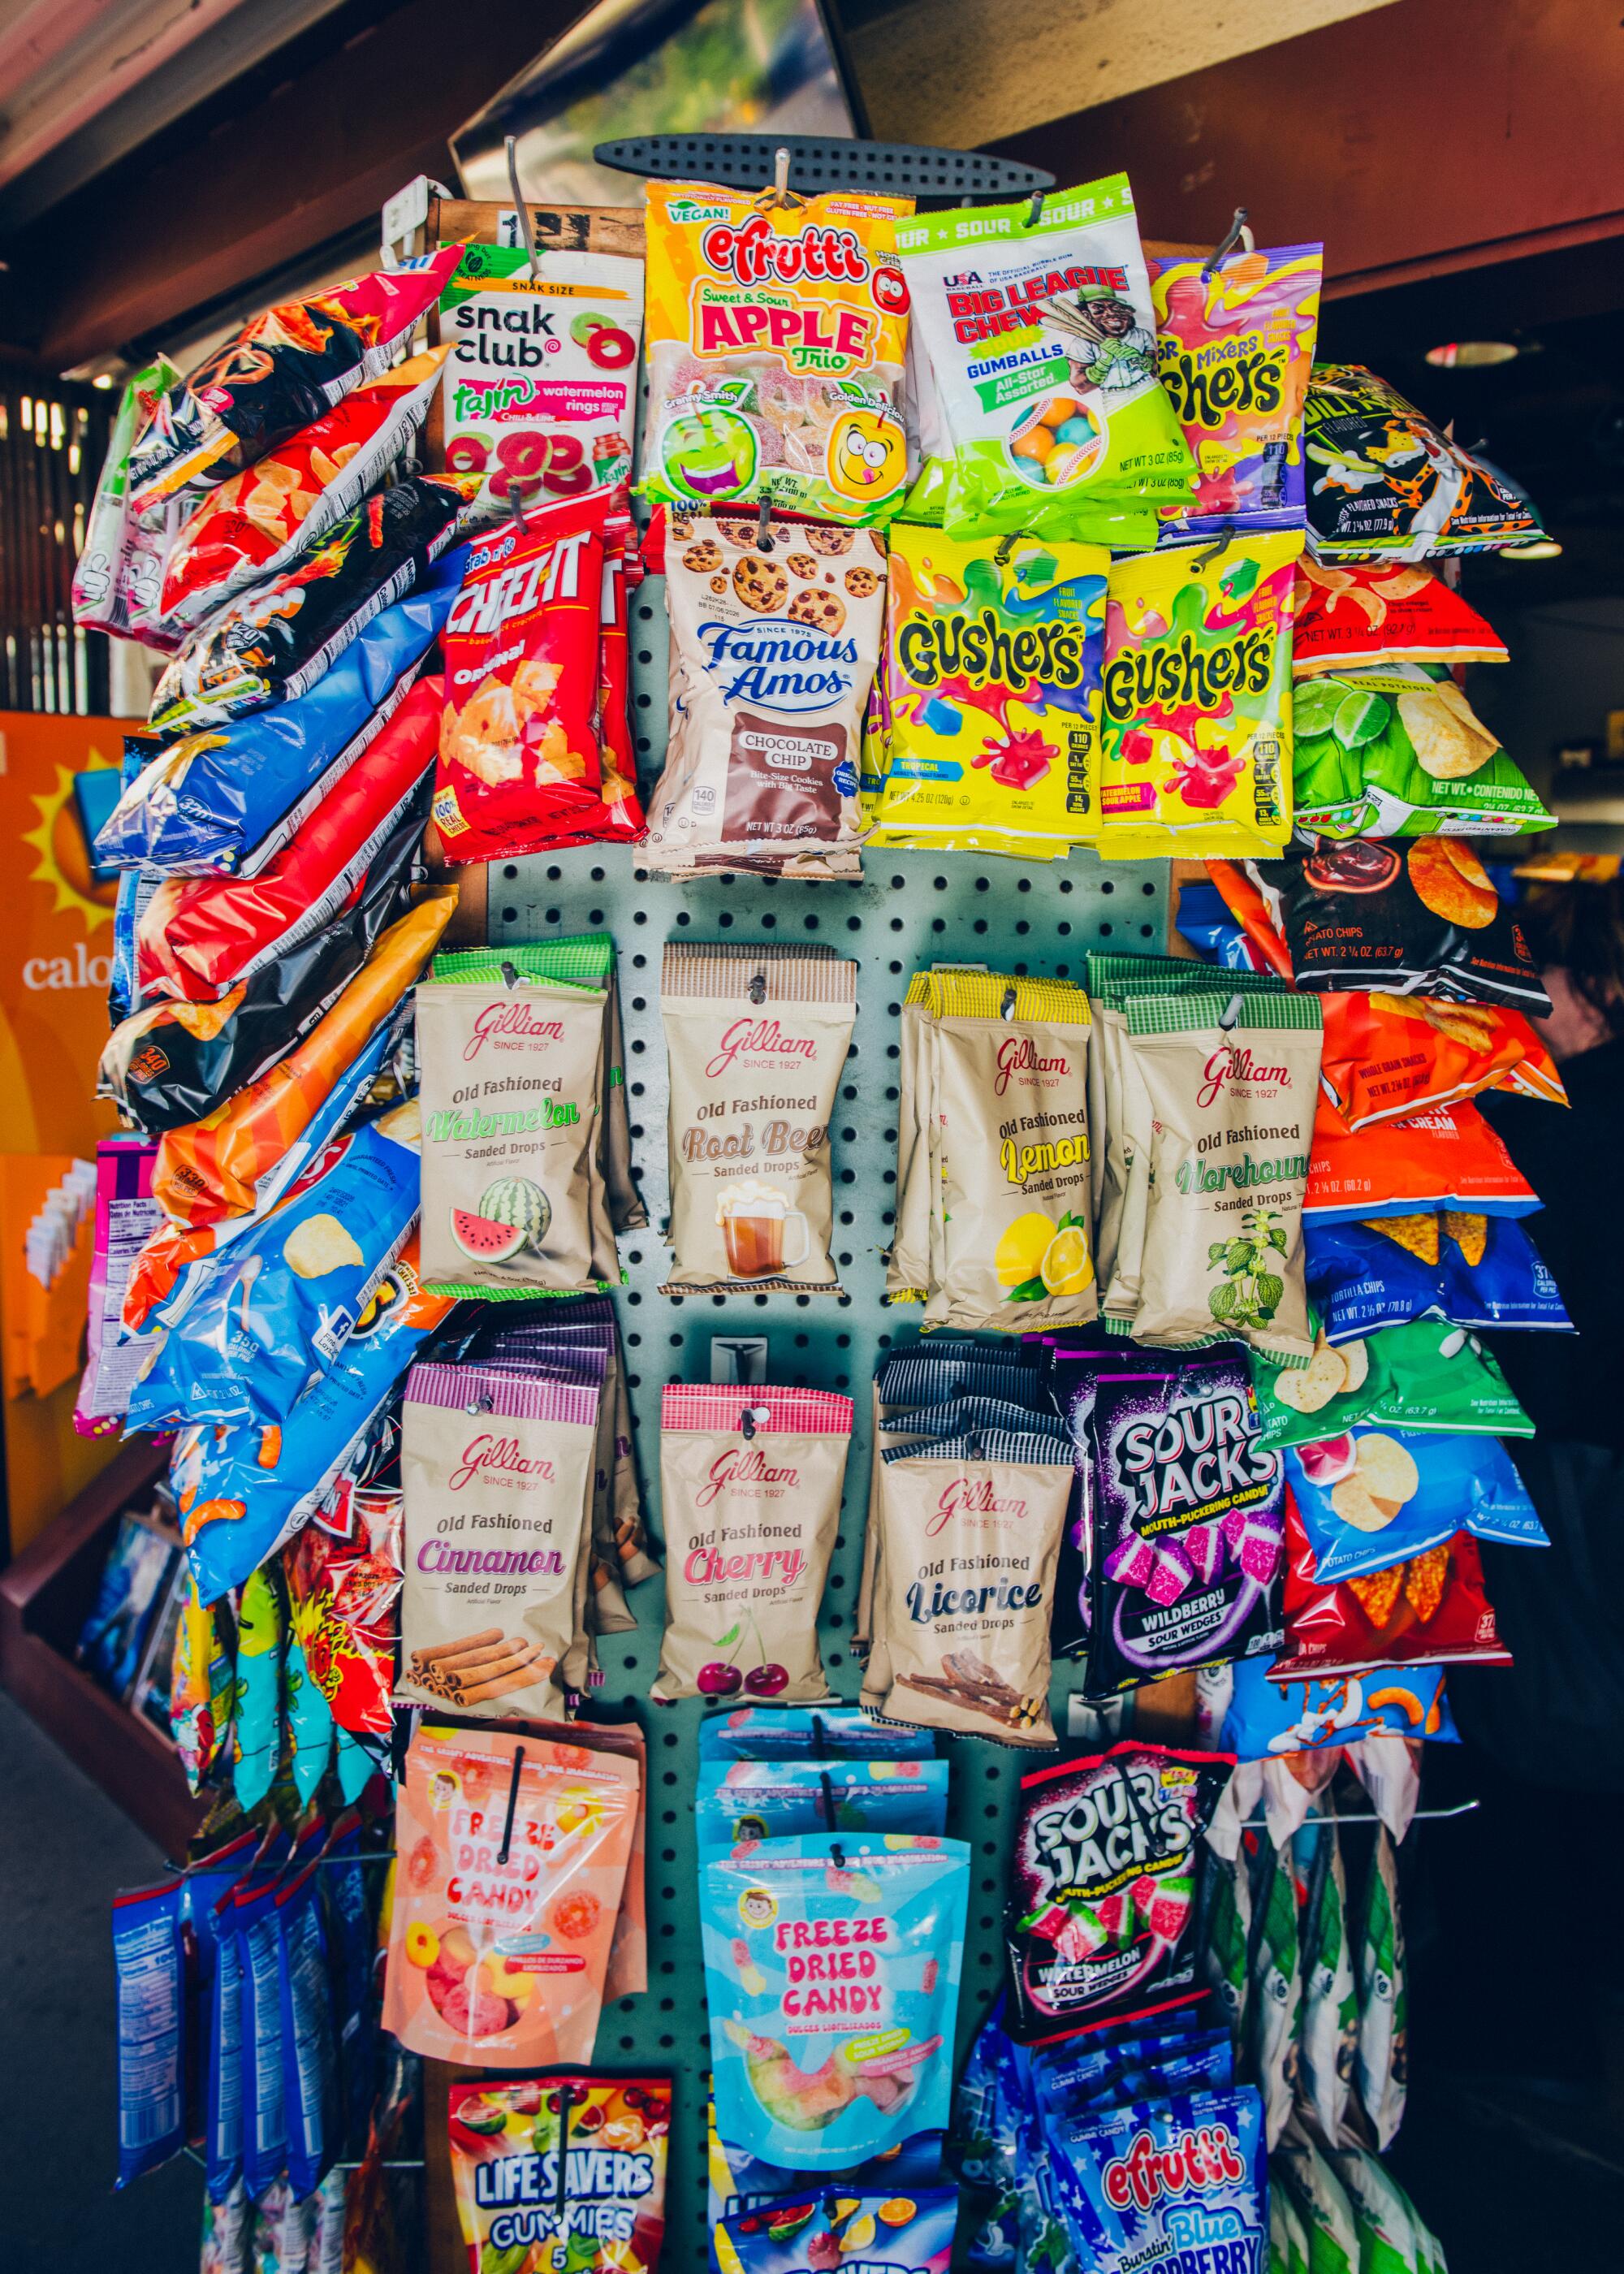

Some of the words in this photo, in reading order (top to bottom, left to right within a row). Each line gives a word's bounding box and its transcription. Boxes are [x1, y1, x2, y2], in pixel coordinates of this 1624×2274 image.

[670, 207, 729, 223] VEGAN!
[956, 218, 1010, 240] SOUR
[706, 217, 869, 286] efrutti
[512, 281, 544, 294] SNAK
[550, 283, 575, 296] SIZE
[943, 270, 983, 287] USA
[703, 289, 741, 304] Sweet
[745, 294, 754, 304] &
[757, 293, 788, 306] Sour
[946, 286, 1005, 318] BIG
[1006, 265, 1129, 309] LEAGUE
[456, 304, 555, 335] snak
[702, 305, 869, 356] APPLE
[454, 333, 543, 368] club
[792, 347, 846, 372] Trio
[967, 344, 1064, 379] GUMBALLS
[996, 365, 1046, 392] All-Star
[996, 374, 1057, 404] Assorted
[542, 386, 623, 400] watermelon
[663, 393, 703, 410] Granny
[702, 390, 739, 403] Smith
[828, 391, 866, 406] Golden
[566, 400, 600, 415] rings
[1120, 460, 1134, 472] NET
[1134, 457, 1147, 469] WT
[1154, 454, 1165, 464] OZ
[1377, 496, 1399, 508] SNACKS
[1059, 586, 1076, 597] FRUIT
[1053, 598, 1082, 610] FLAVORED
[1058, 609, 1079, 620] SNACKS
[756, 626, 788, 634] SINCE
[791, 628, 812, 638] 1975
[1307, 629, 1324, 643] NET
[1327, 627, 1344, 642] WT.
[697, 622, 859, 672] Famous
[899, 611, 1083, 690] Gushers
[1105, 627, 1274, 720] Gushers
[719, 666, 853, 705] Amos
[1353, 680, 1379, 690] REAL
[1382, 682, 1432, 693] POTATOES
[1061, 721, 1072, 729] PER
[745, 734, 832, 757] CHOCOLATE
[1072, 733, 1088, 744] 110
[771, 753, 806, 767] CHIP
[900, 761, 939, 772] TROPICAL
[750, 771, 789, 782] Bite-Size
[791, 776, 823, 787] Cookies
[756, 780, 775, 789] with
[793, 785, 818, 794] Taste
[838, 777, 857, 789] RECIPE
[1432, 781, 1449, 795] NET
[1450, 783, 1466, 796] WT.
[1474, 785, 1522, 799] CONTENIDO
[694, 789, 714, 802] 140
[926, 793, 935, 804] OZ
[440, 815, 461, 829] REAL
[447, 821, 469, 838] CHEESE
[747, 822, 762, 832] NET
[1336, 926, 1363, 939] CHIPS
[1321, 946, 1338, 959] WT.
[1340, 946, 1346, 958] 2
[464, 1002, 564, 1061] Gilliam
[494, 1041, 525, 1052] SINCE
[528, 1042, 549, 1053] 1927
[705, 1018, 818, 1079] Gilliam
[140, 1048, 167, 1071] 340
[742, 1058, 775, 1070] SINCE
[779, 1061, 801, 1070] 1927
[995, 1038, 1070, 1096] Gilliam
[1358, 1061, 1384, 1079] WHOLE
[1018, 1076, 1040, 1087] SINCE
[1041, 1078, 1060, 1088] 1927
[1196, 1047, 1291, 1109] Gilliam
[452, 1083, 479, 1105] Old
[484, 1077, 563, 1096] Fashioned
[1229, 1087, 1252, 1098] SINCE
[1255, 1089, 1277, 1099] 1927
[697, 1100, 726, 1122] Old
[732, 1095, 817, 1115] Fashioned
[425, 1098, 580, 1143] Watermelon
[998, 1120, 1019, 1140] Old
[1021, 1109, 1086, 1134] Fashioned
[1409, 1118, 1457, 1133] CREAM
[682, 1122, 754, 1164] Root
[1197, 1132, 1222, 1154] Old
[1227, 1124, 1300, 1147] Fashioned
[464, 1143, 506, 1161] Sanded
[510, 1141, 546, 1156] Drops
[1000, 1132, 1091, 1187] Lemon
[713, 1163, 760, 1178] Sanded
[763, 1159, 800, 1175] Drops
[1307, 1161, 1331, 1175] CHIPS
[1021, 1180, 1054, 1197] Sanded
[1056, 1173, 1085, 1191] Drops
[1213, 1196, 1254, 1213] Sanded
[1256, 1191, 1293, 1208] Drops
[1331, 1286, 1363, 1304] TORTILLA
[1364, 1281, 1385, 1295] CHIPS
[1332, 1308, 1347, 1324] NET
[1348, 1307, 1360, 1321] WT.
[230, 1330, 260, 1354] 350
[1126, 1398, 1243, 1473] SOUR
[448, 1433, 555, 1491] Gilliam
[483, 1476, 513, 1489] SINCE
[516, 1481, 539, 1491] 1927
[695, 1449, 801, 1508] Gilliam
[731, 1488, 762, 1498] SINCE
[764, 1489, 785, 1498] 1927
[925, 1478, 1028, 1537] Gilliam
[1140, 1498, 1232, 1537] MOUTH-PUCKERING
[437, 1515, 464, 1534] Old
[470, 1513, 552, 1535] Fashioned
[961, 1518, 990, 1528] SINCE
[991, 1519, 1014, 1529] 1927
[689, 1530, 716, 1551] Old
[721, 1523, 802, 1543] Fashioned
[416, 1537, 567, 1576] Cinnamon
[1354, 1548, 1376, 1561] CHIPS
[683, 1546, 808, 1587] Cherry
[918, 1559, 944, 1580] Old
[951, 1554, 1030, 1572] Fashioned
[444, 1581, 490, 1595] Sanded
[494, 1583, 527, 1597] Drops
[704, 1589, 748, 1604] Sanded
[753, 1586, 787, 1600] Drops
[905, 1576, 1043, 1625] Licorice
[1142, 1588, 1224, 1632] WILDBERRY
[933, 1620, 978, 1634] Sanded
[981, 1619, 1014, 1631] Drops
[1148, 1628, 1181, 1649] SOUR
[1183, 1610, 1222, 1636] WEDGES
[1036, 1776, 1160, 1853] SOUR
[453, 1808, 555, 1851] FREEZE
[447, 1877, 539, 1914] CANDY
[775, 1917, 888, 1950] FREEZE
[787, 1950, 877, 1984] DRIED
[1038, 1947, 1141, 1985] WATERMELON
[1052, 1983, 1086, 1999] SOUR
[1087, 1971, 1129, 1990] WEDGES
[781, 1985, 883, 2019] CANDY
[787, 2021, 821, 2035] DULCES
[1107, 2128, 1241, 2209] efrutti
[1169, 2211, 1240, 2249] Blue
[552, 2248, 568, 2269] 5
[1117, 2235, 1172, 2274] Burstin'
